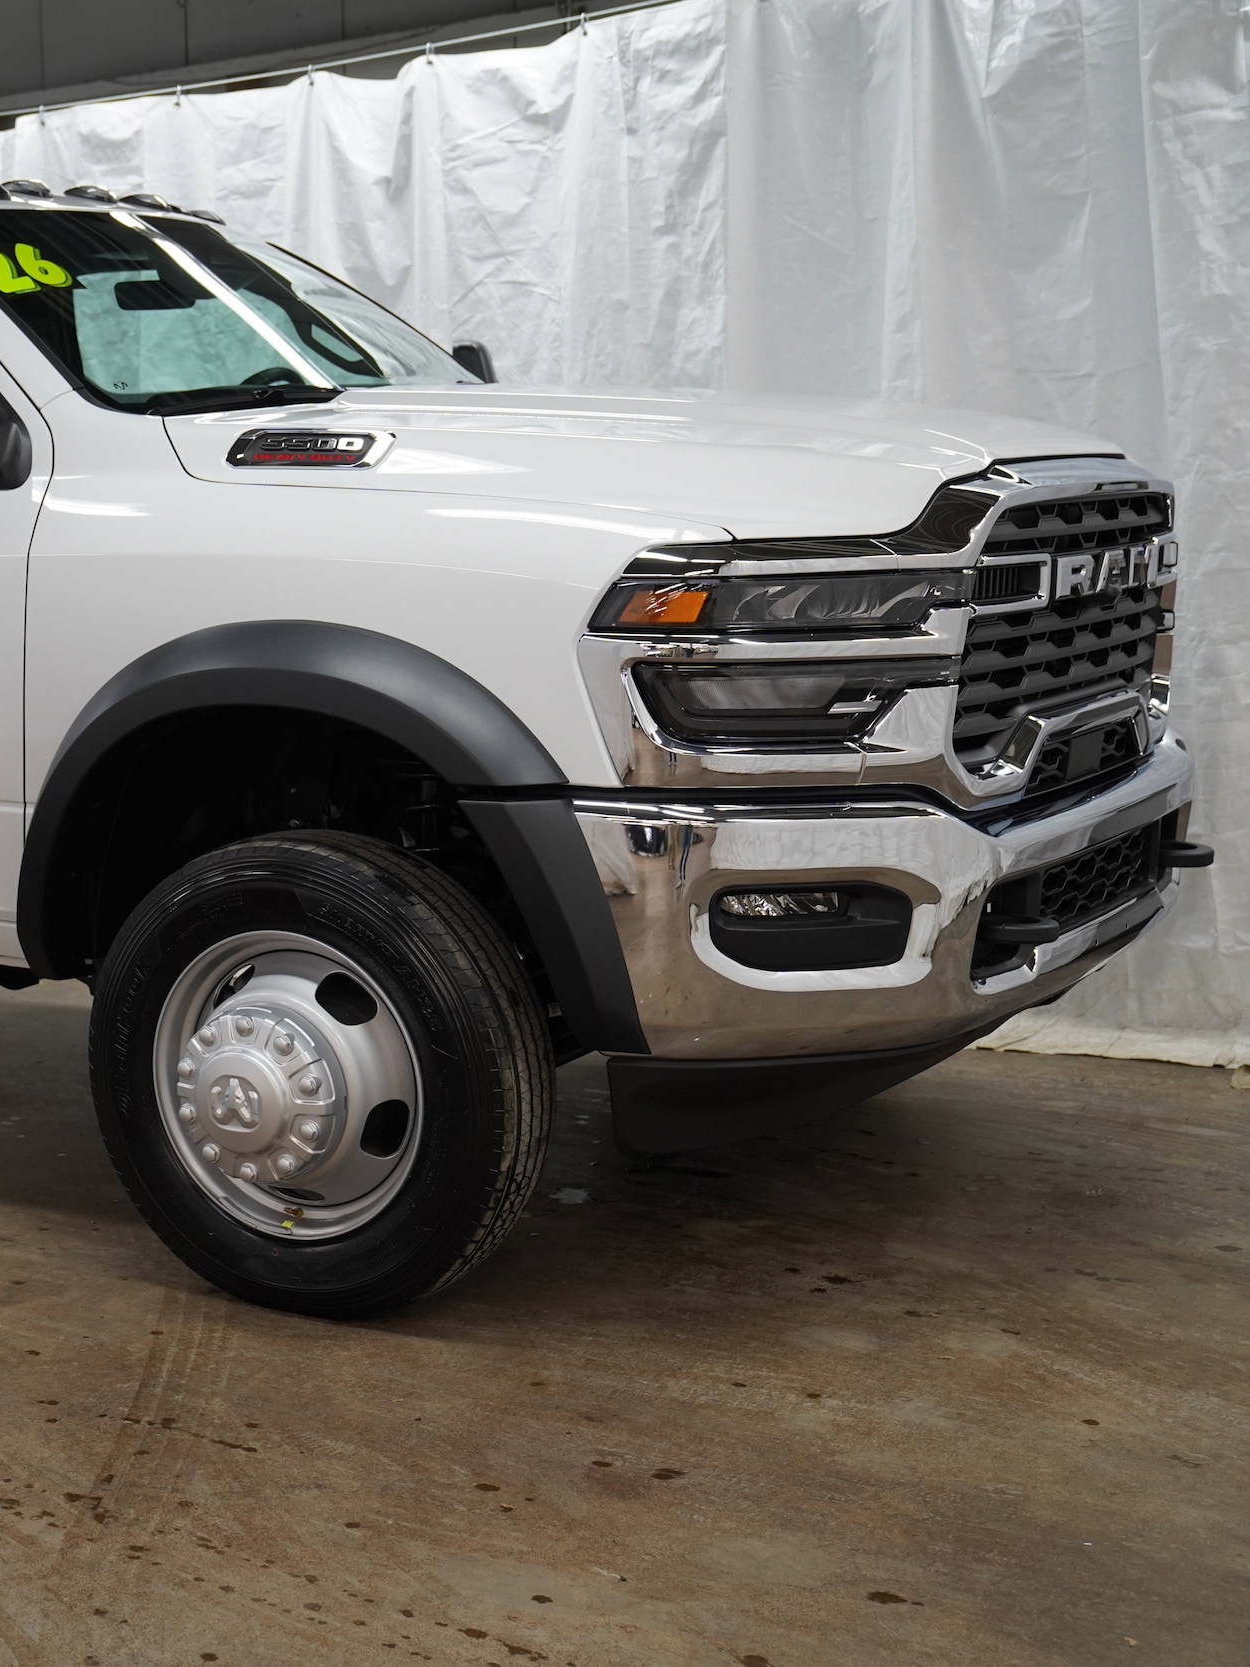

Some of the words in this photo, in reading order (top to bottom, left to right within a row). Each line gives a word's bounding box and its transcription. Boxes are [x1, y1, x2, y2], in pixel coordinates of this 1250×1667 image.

[260, 437, 364, 451] 5500
[253, 453, 307, 461] HEAVY
[310, 454, 356, 462] DUTY
[1056, 542, 1159, 600] RAM
